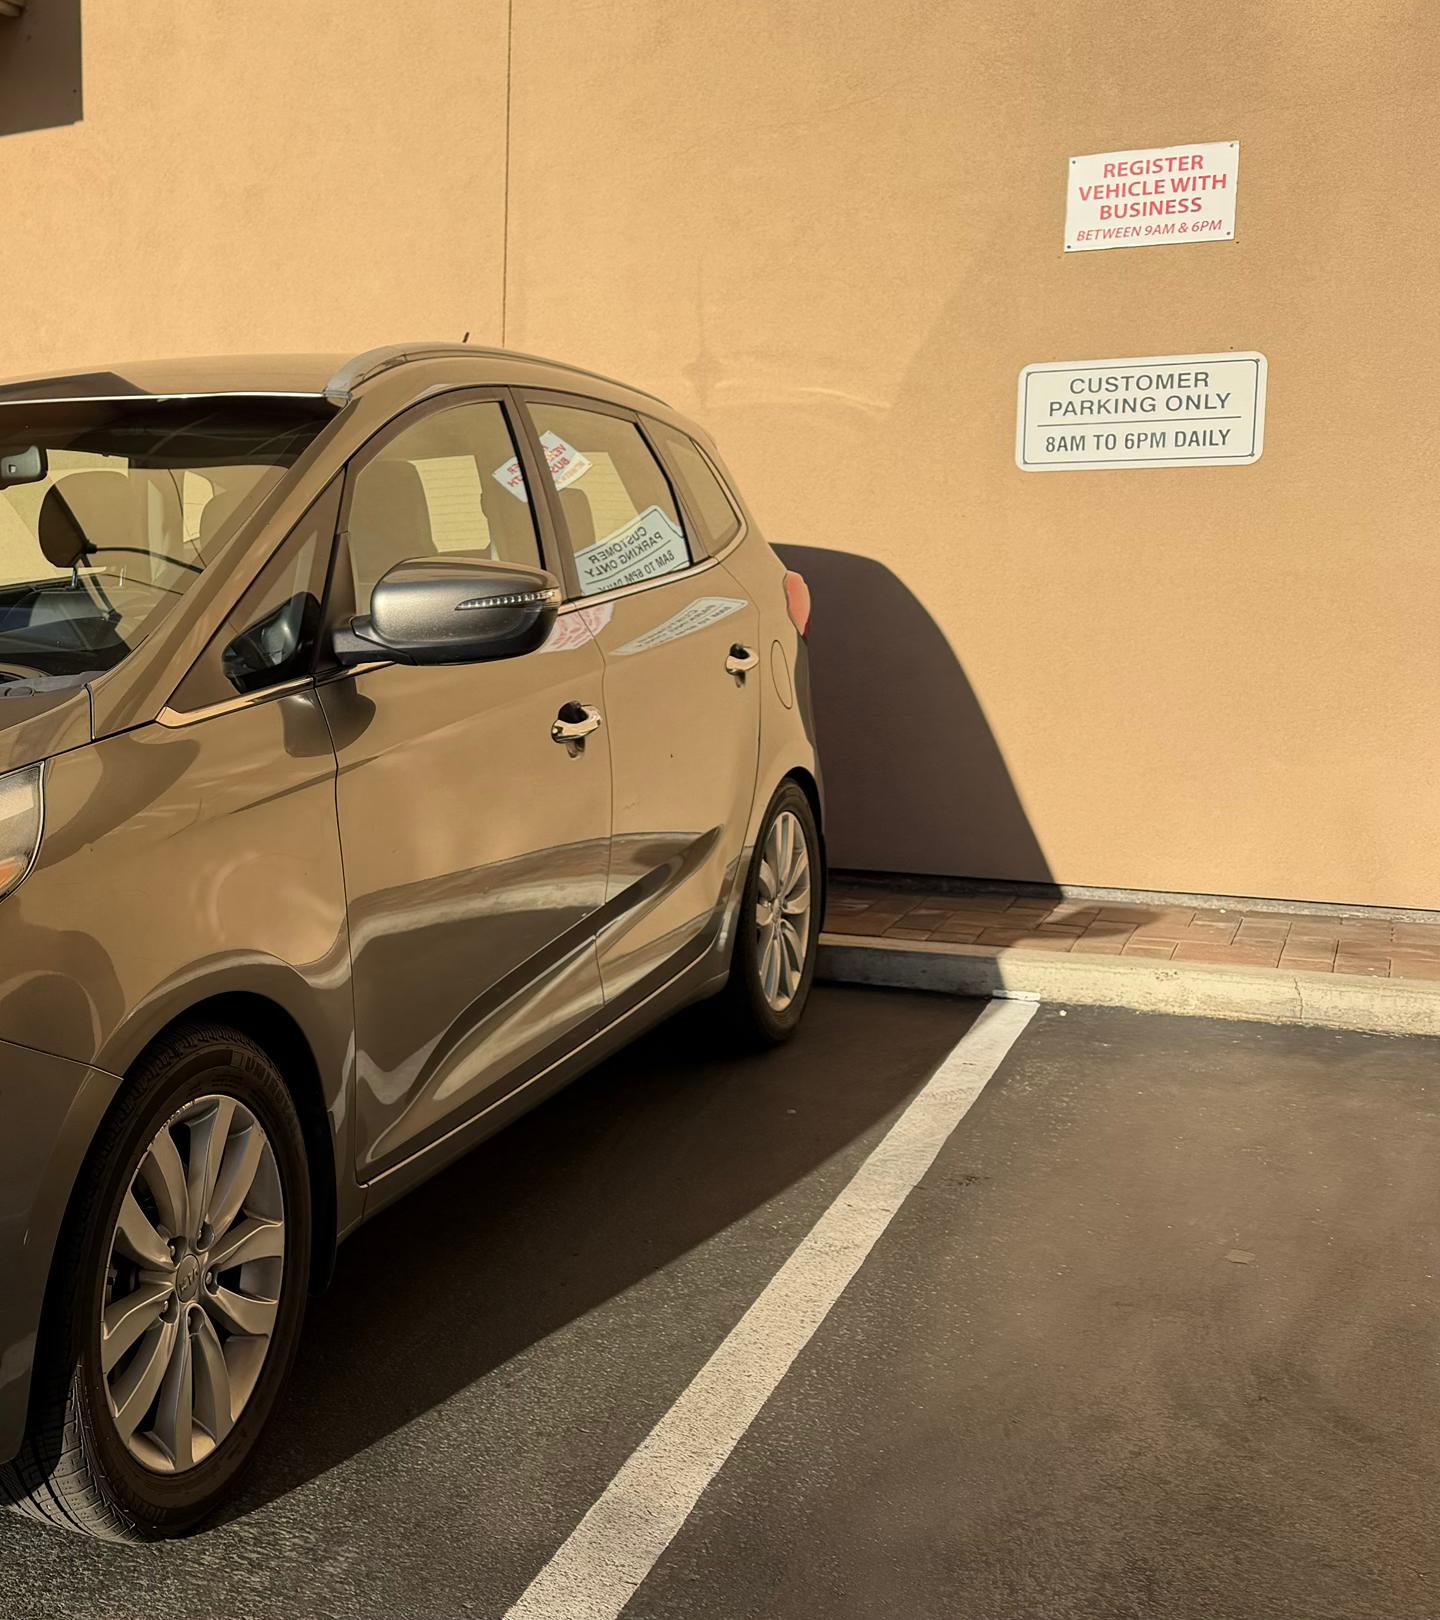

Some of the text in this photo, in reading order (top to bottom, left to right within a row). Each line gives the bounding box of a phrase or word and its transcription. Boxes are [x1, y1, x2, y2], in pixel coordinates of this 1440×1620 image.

[1103, 154, 1204, 178] REGISTER
[1078, 174, 1227, 201] VEHICLE WITH
[1099, 197, 1203, 220] BUSINESS
[1076, 219, 1223, 241] BETWEEN 9AM & 6PM
[1069, 371, 1210, 394] CUSTOMER
[1049, 392, 1231, 417] PARKING ONLY
[1045, 428, 1231, 453] 8AM TO 6PM DAILY
